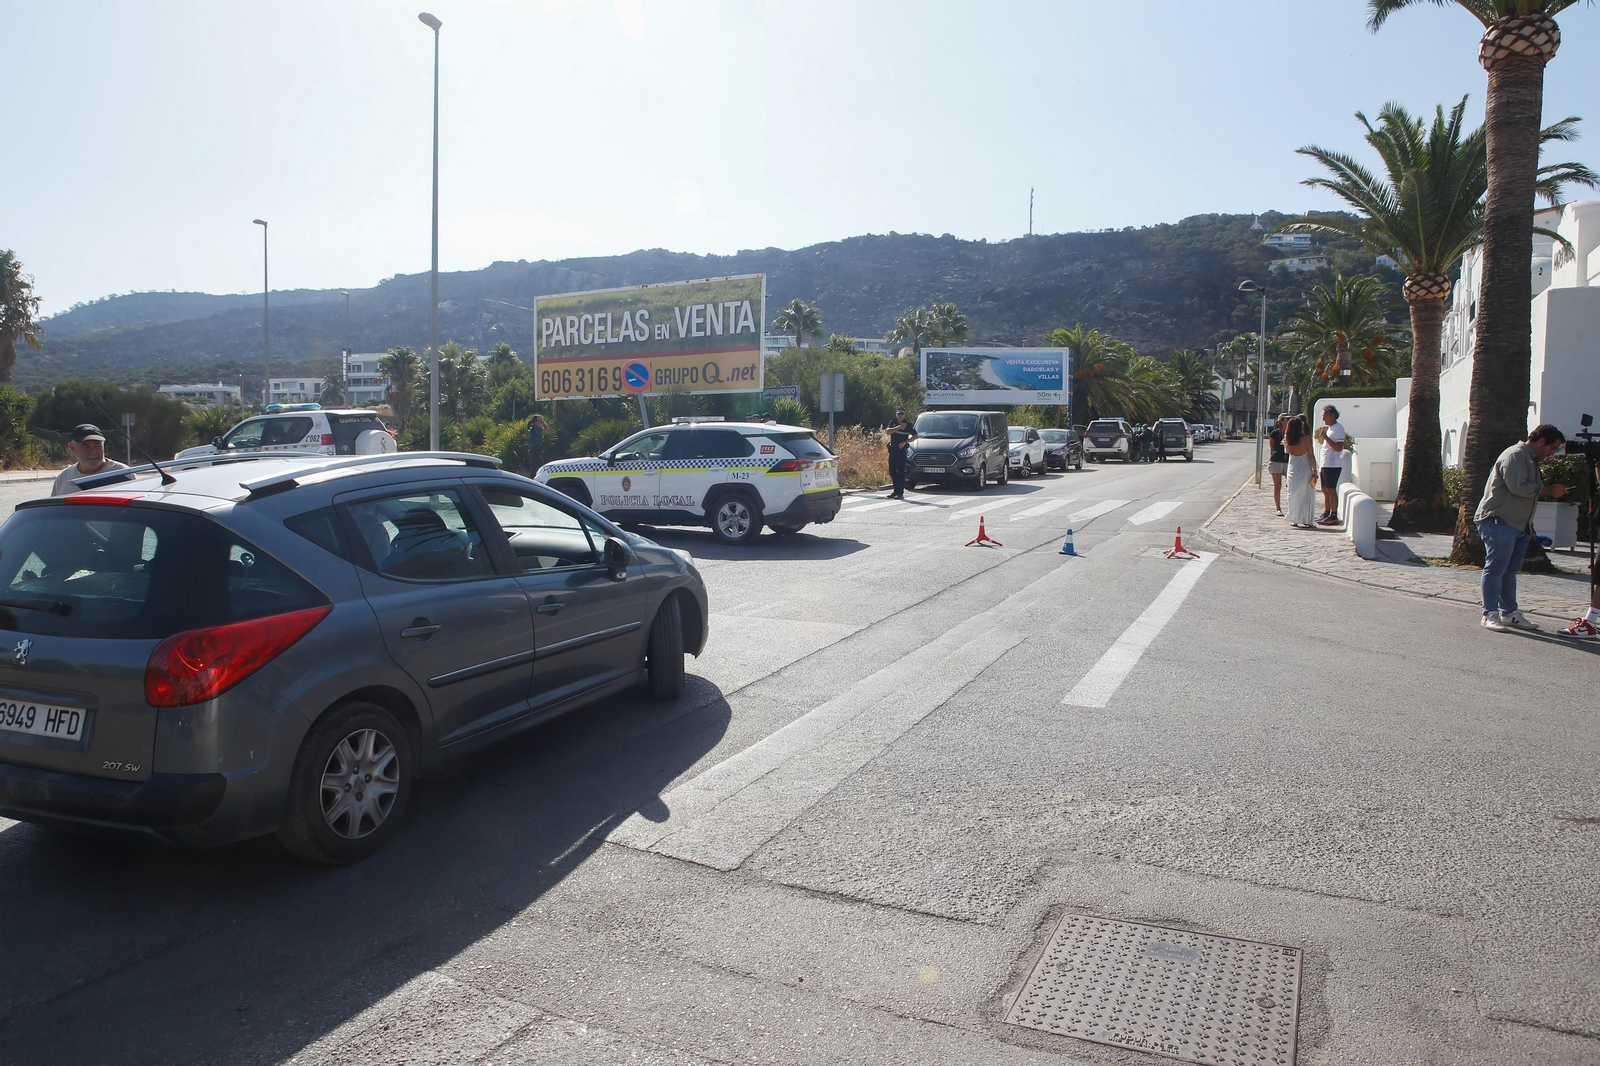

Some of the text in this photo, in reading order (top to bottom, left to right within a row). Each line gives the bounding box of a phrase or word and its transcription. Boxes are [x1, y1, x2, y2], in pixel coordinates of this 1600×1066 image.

[542, 300, 756, 348] PARCELAS EN VENTA
[655, 366, 699, 386] GRUPO
[731, 472, 750, 480] M-23
[600, 494, 696, 507] POLICIA LOCAL
[44, 707, 80, 735] HFD
[102, 760, 141, 772] 207 SW
